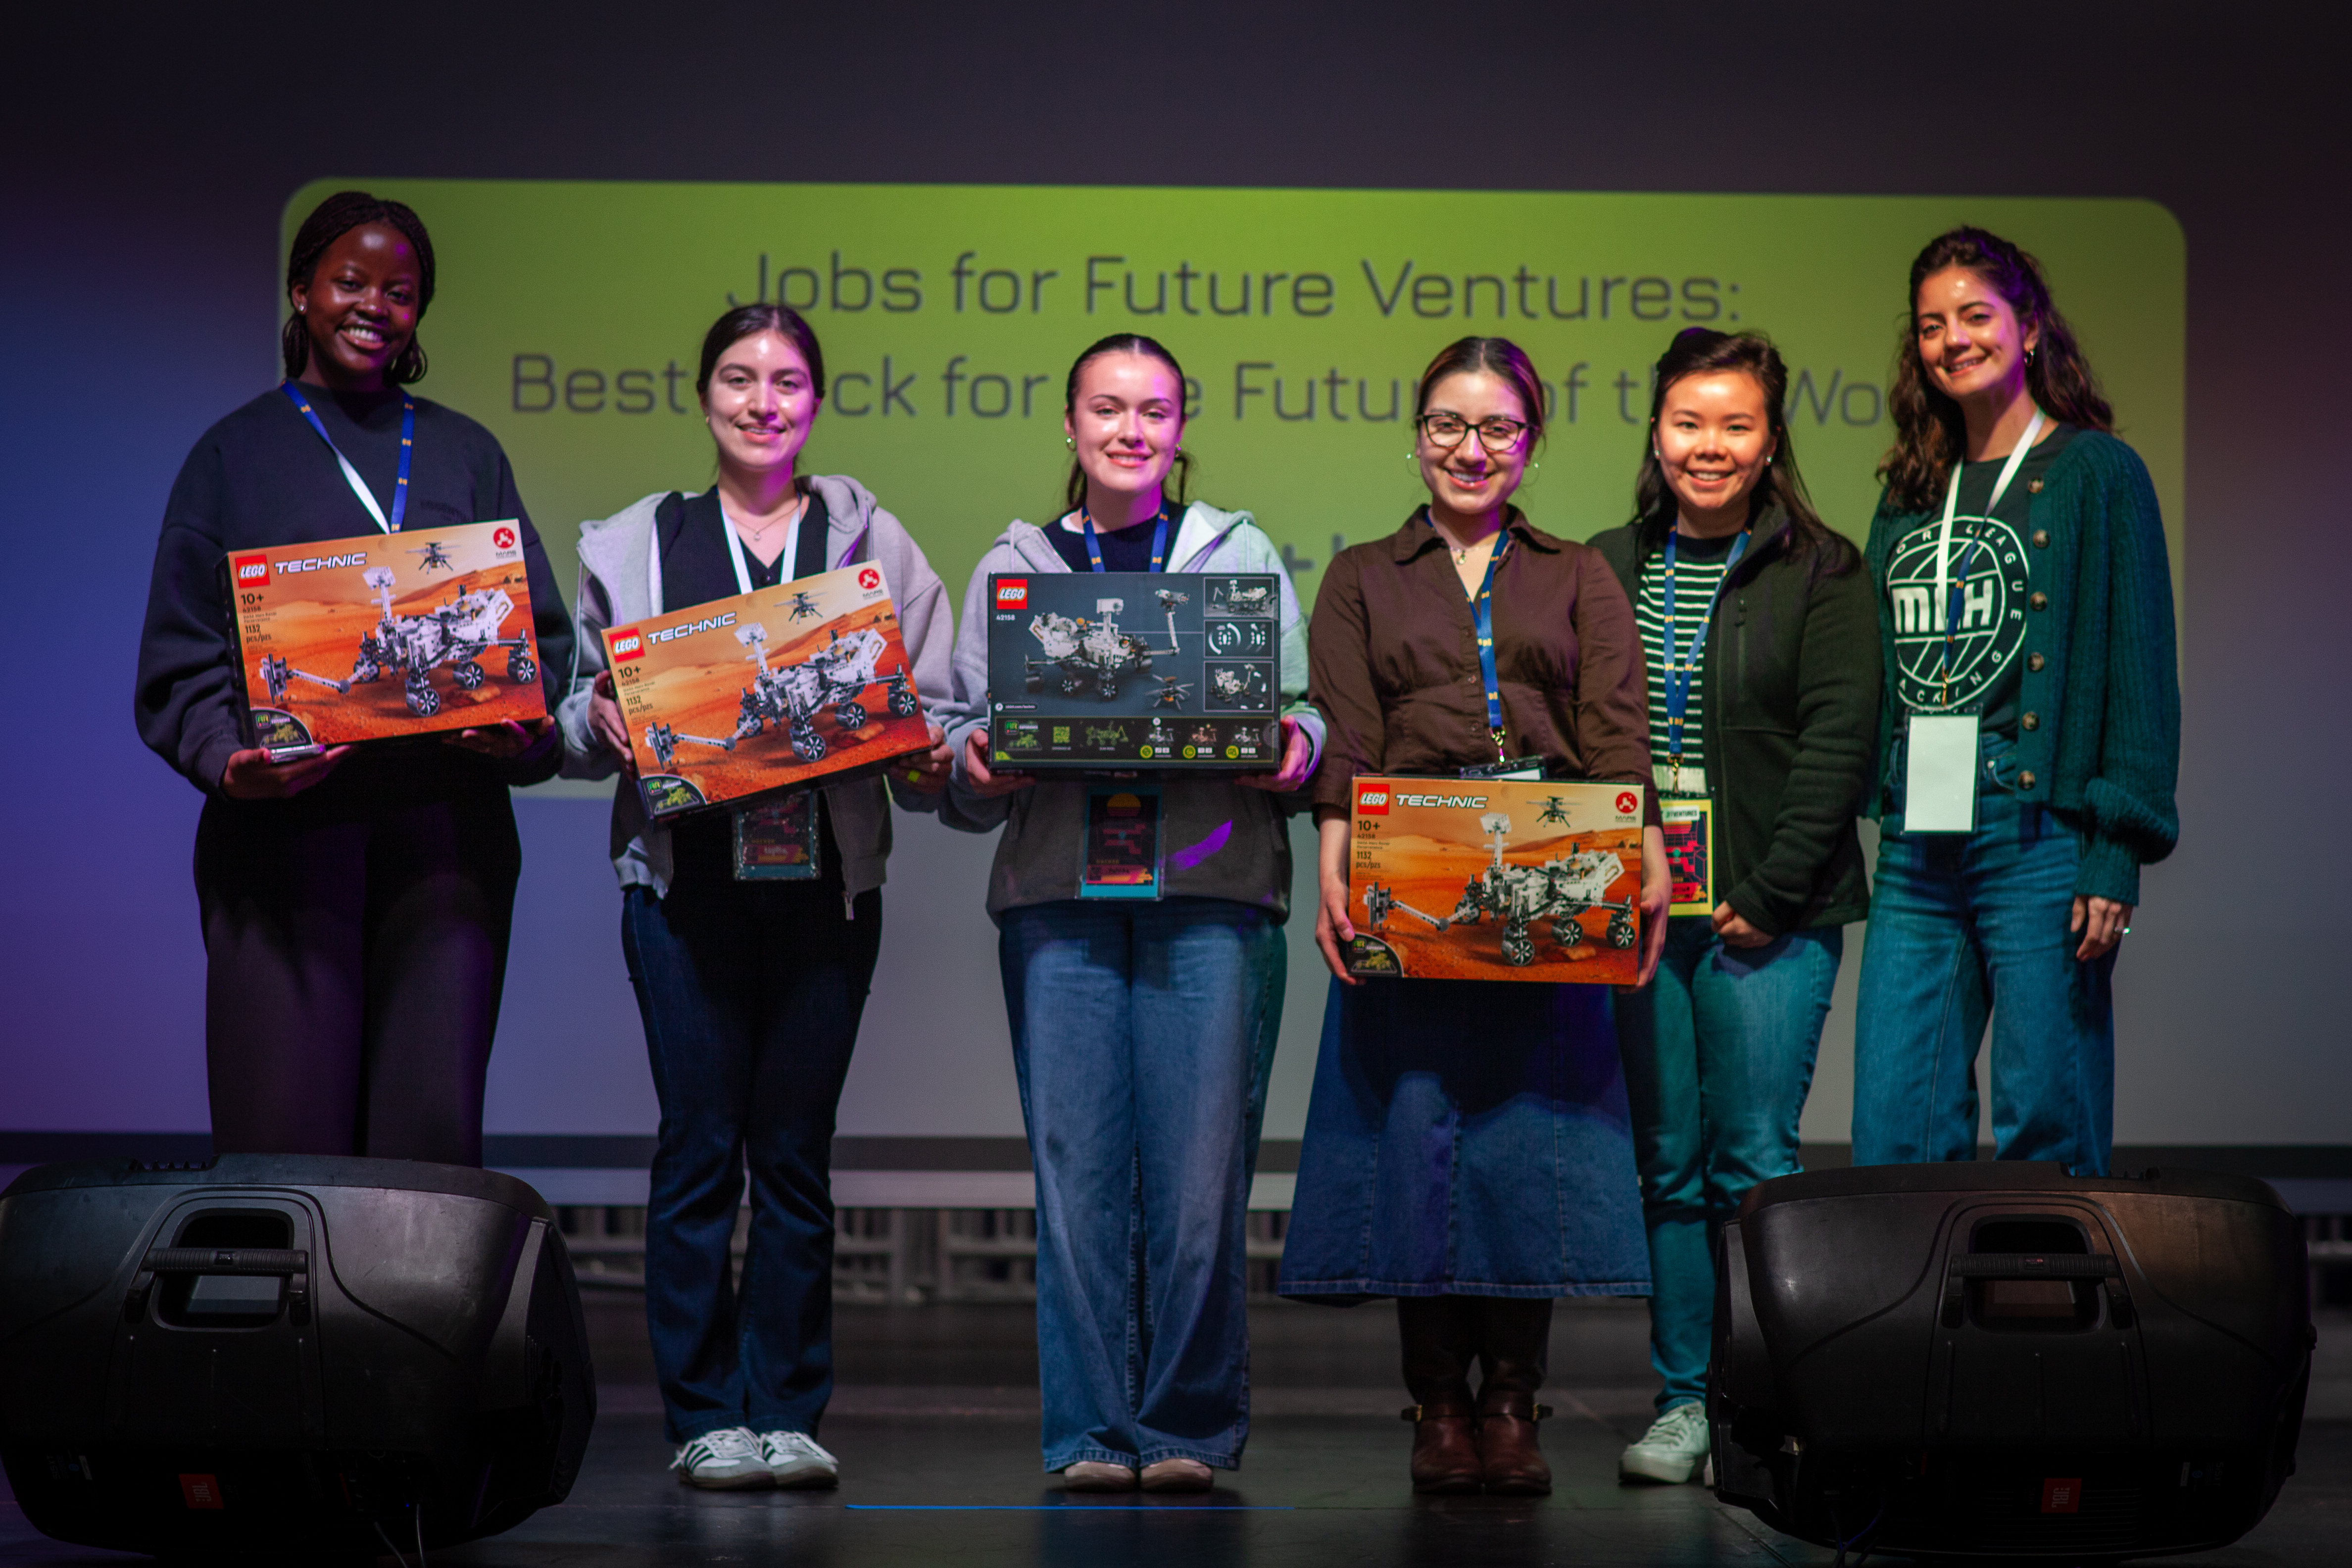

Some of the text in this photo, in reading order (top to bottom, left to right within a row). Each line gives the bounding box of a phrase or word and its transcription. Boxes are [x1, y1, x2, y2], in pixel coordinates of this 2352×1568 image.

[726, 250, 1741, 322] Jobs for Future Ventures:
[512, 353, 690, 415] Best
[942, 355, 1050, 418] for
[1235, 362, 1420, 422] Futu
[240, 552, 367, 579] LEGO TECHNIC
[1965, 524, 2024, 621] LEAGUE
[241, 593, 264, 605] 10+
[999, 588, 1026, 600] LEGO
[245, 624, 261, 634] 1132
[615, 612, 736, 654] LEGO TECHNIC
[618, 665, 641, 679] 10+
[1899, 650, 2003, 703] ACKING
[626, 695, 641, 706] 1132
[1361, 793, 1488, 809] LEGO TECHNIC
[1358, 820, 1380, 831] 10+
[1357, 851, 1372, 859] 1132
[1356, 859, 1381, 870] pcs/pzs
[192, 1481, 212, 1502] JBL
[2052, 1487, 2070, 1508] JBL
